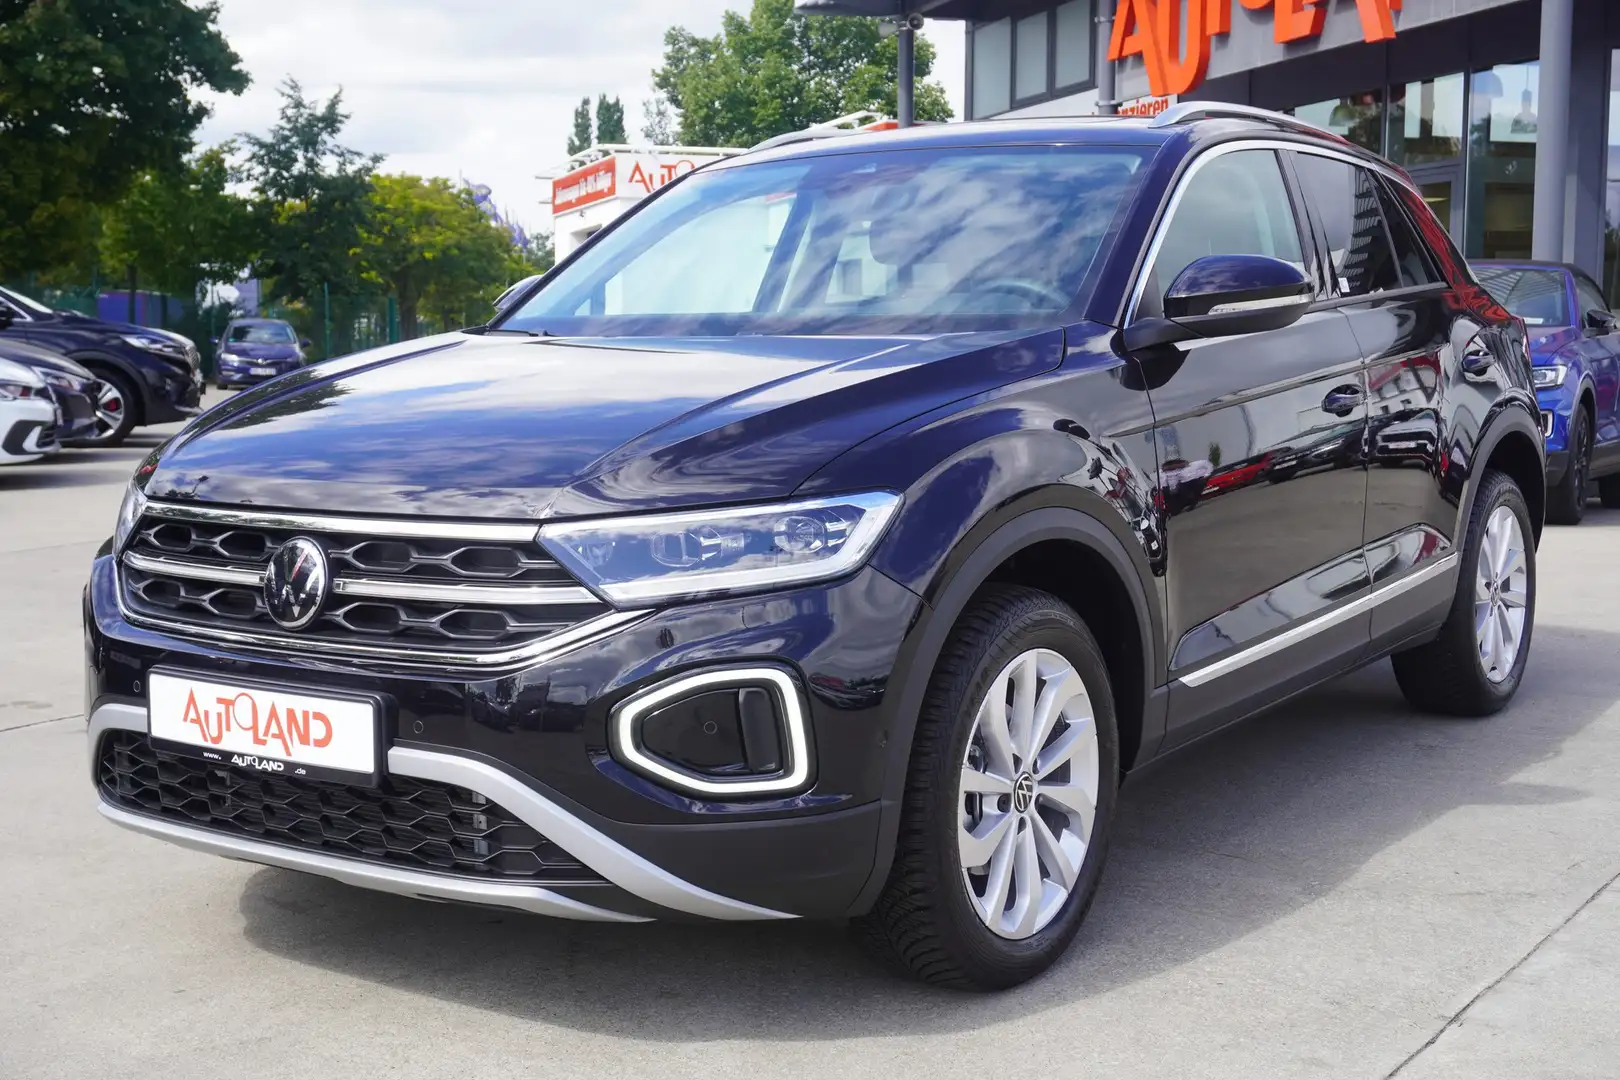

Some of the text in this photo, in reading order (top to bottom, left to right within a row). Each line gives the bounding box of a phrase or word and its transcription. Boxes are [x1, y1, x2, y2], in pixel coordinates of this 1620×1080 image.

[182, 687, 333, 757] AUTOLAND
[203, 752, 222, 760] www.
[231, 755, 284, 771] AUTOLAND
